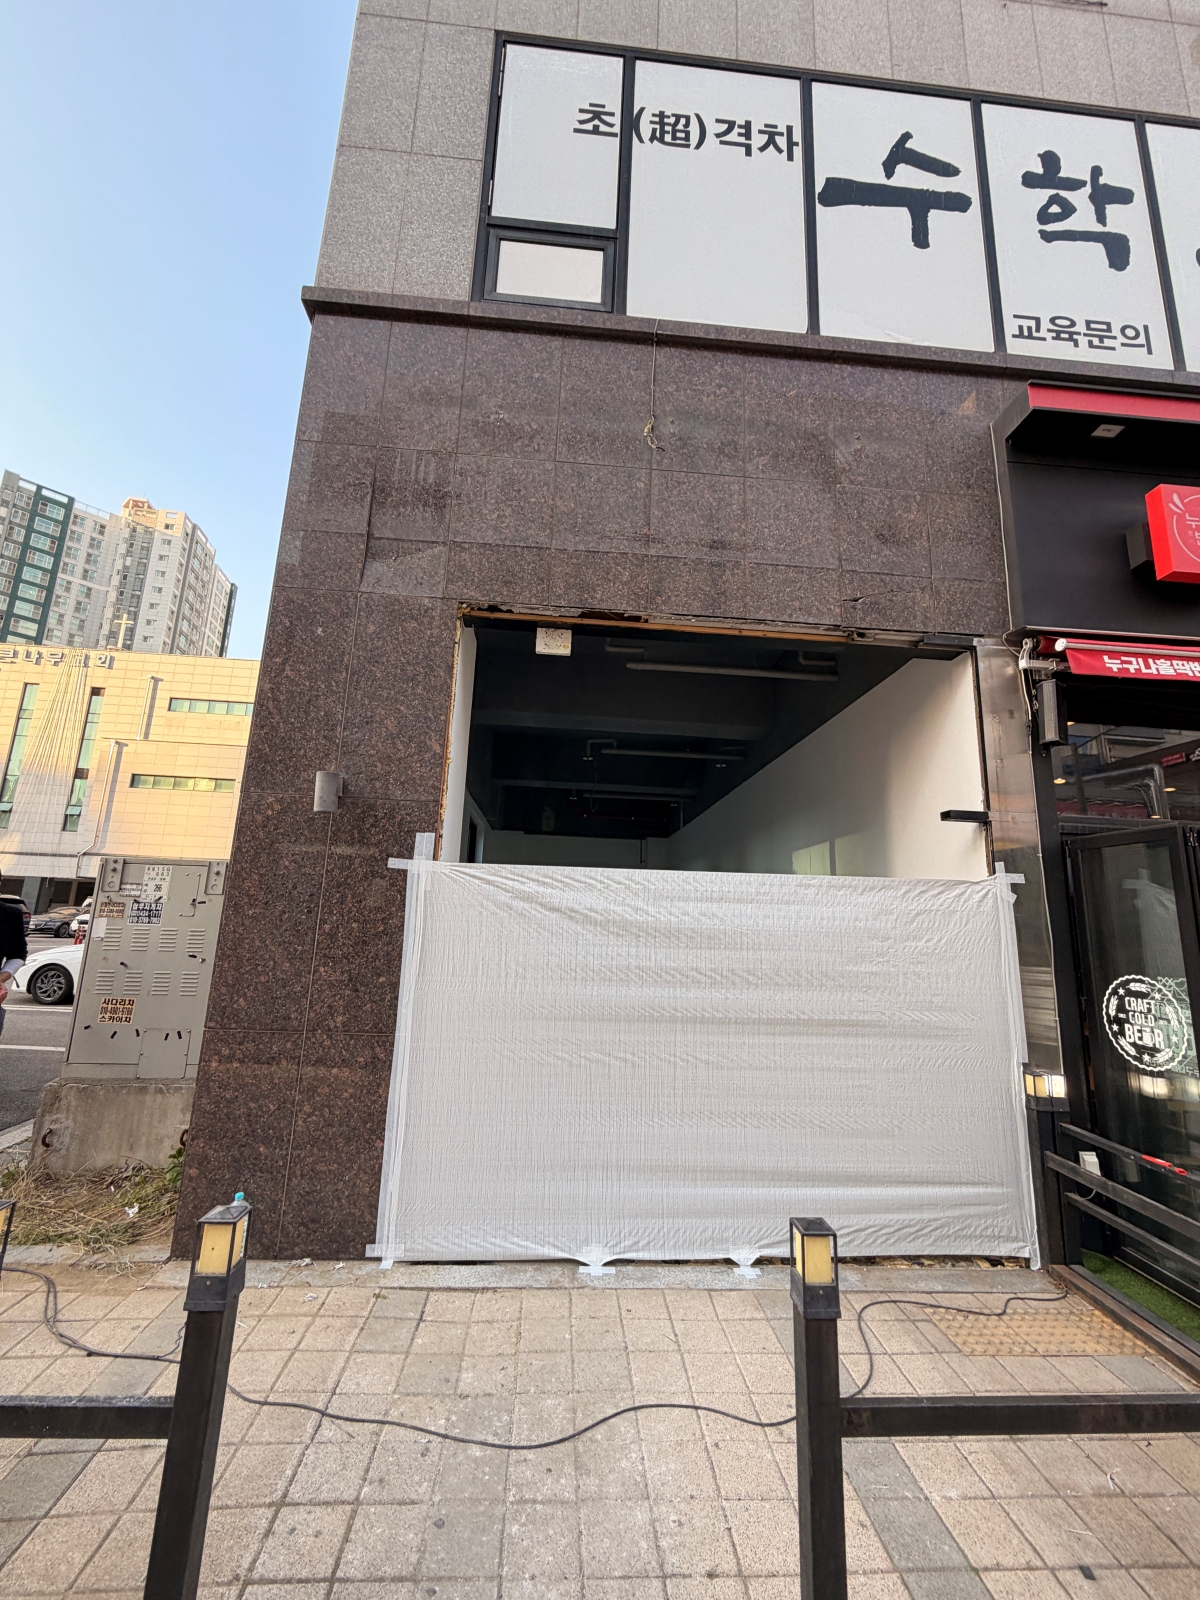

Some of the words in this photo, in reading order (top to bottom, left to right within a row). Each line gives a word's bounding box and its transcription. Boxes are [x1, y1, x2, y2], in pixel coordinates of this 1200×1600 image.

[818, 131, 1135, 272] 수학
[1011, 313, 1154, 356] 교육문의
[102, 998, 135, 1006] 사다리차
[1125, 997, 1155, 1014] CRAFT
[99, 1015, 132, 1024] 스카이차
[1128, 1011, 1155, 1027] COLD
